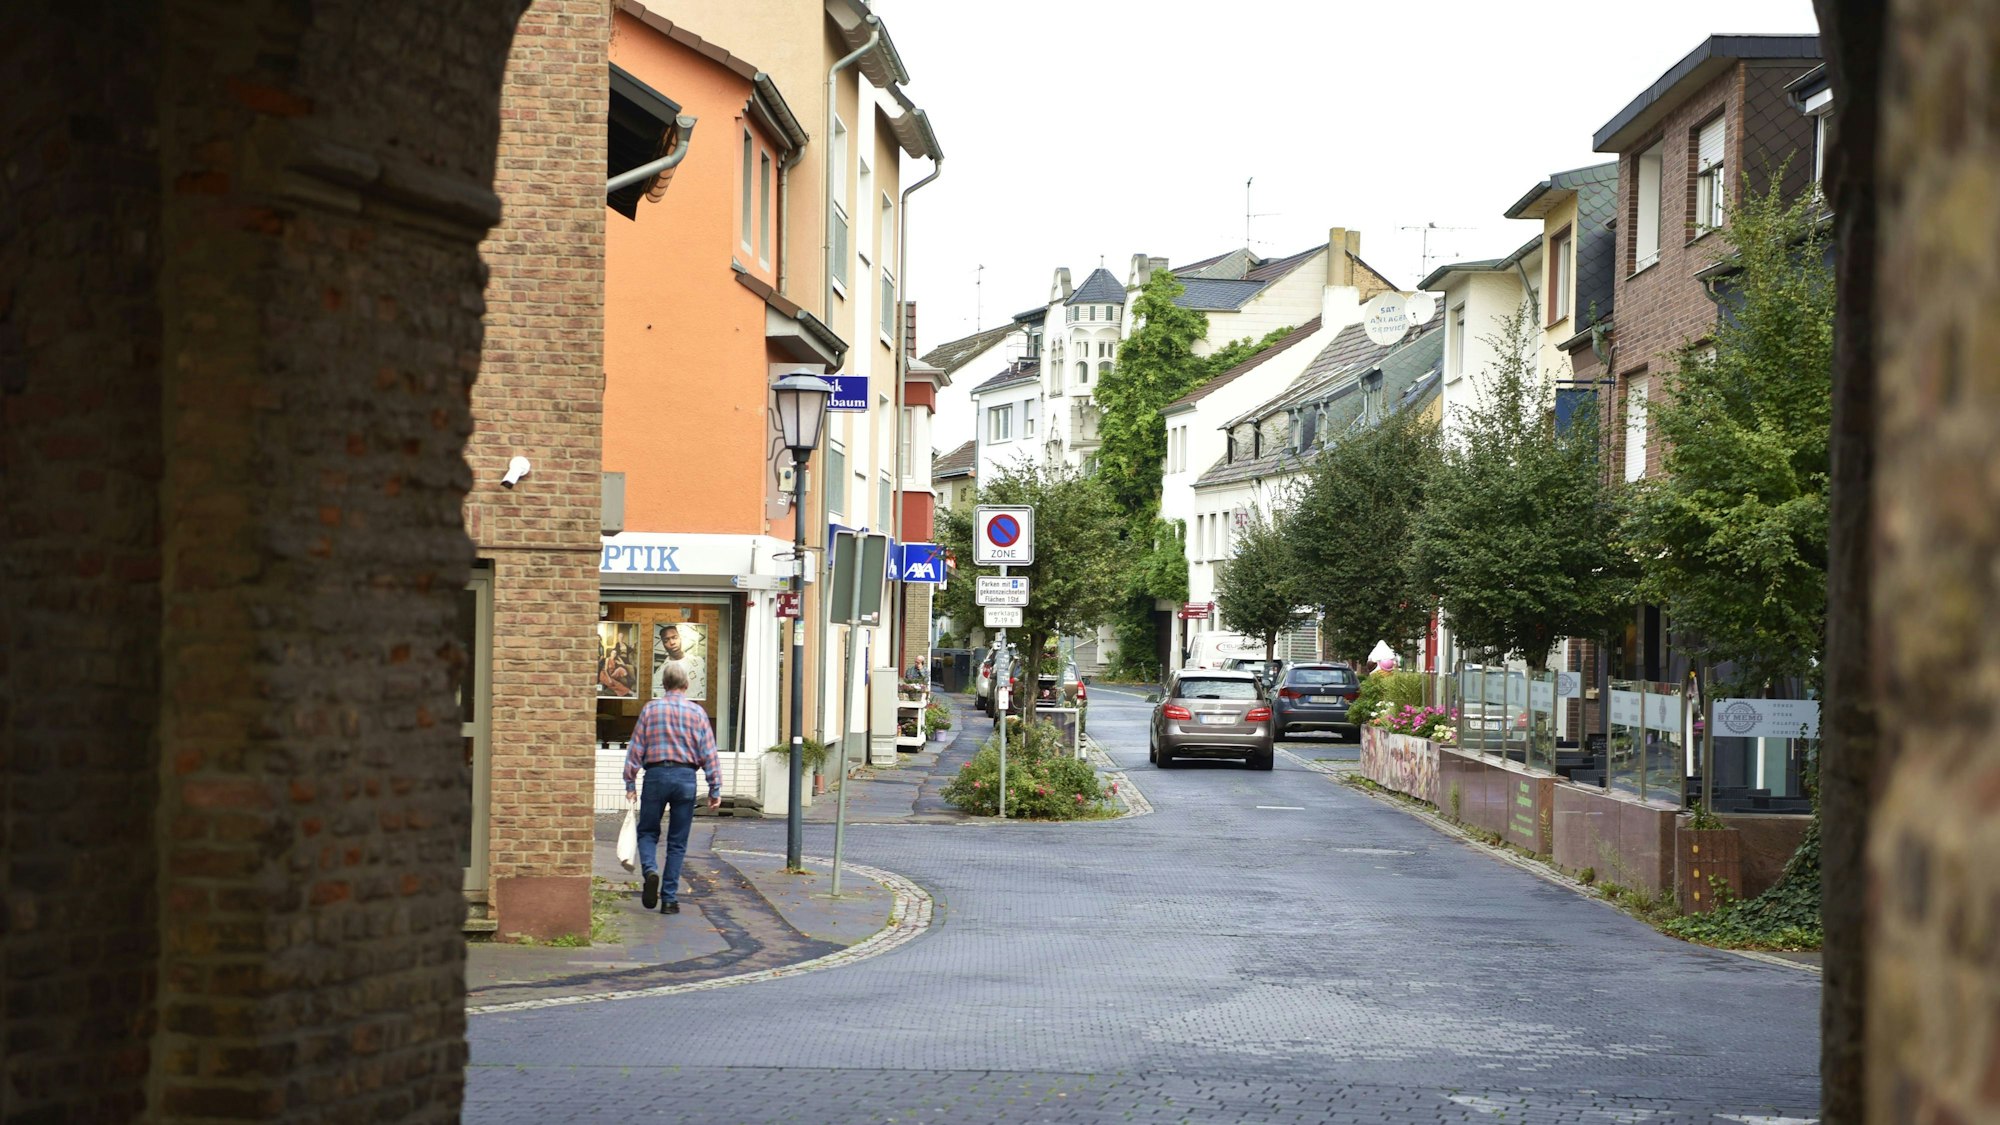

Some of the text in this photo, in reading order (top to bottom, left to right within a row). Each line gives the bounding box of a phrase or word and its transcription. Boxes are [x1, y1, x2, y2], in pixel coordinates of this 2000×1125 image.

[991, 549, 1017, 558] ZONE
[904, 562, 936, 579] AXA
[981, 580, 1000, 588] Parken
[1002, 580, 1011, 588] mit
